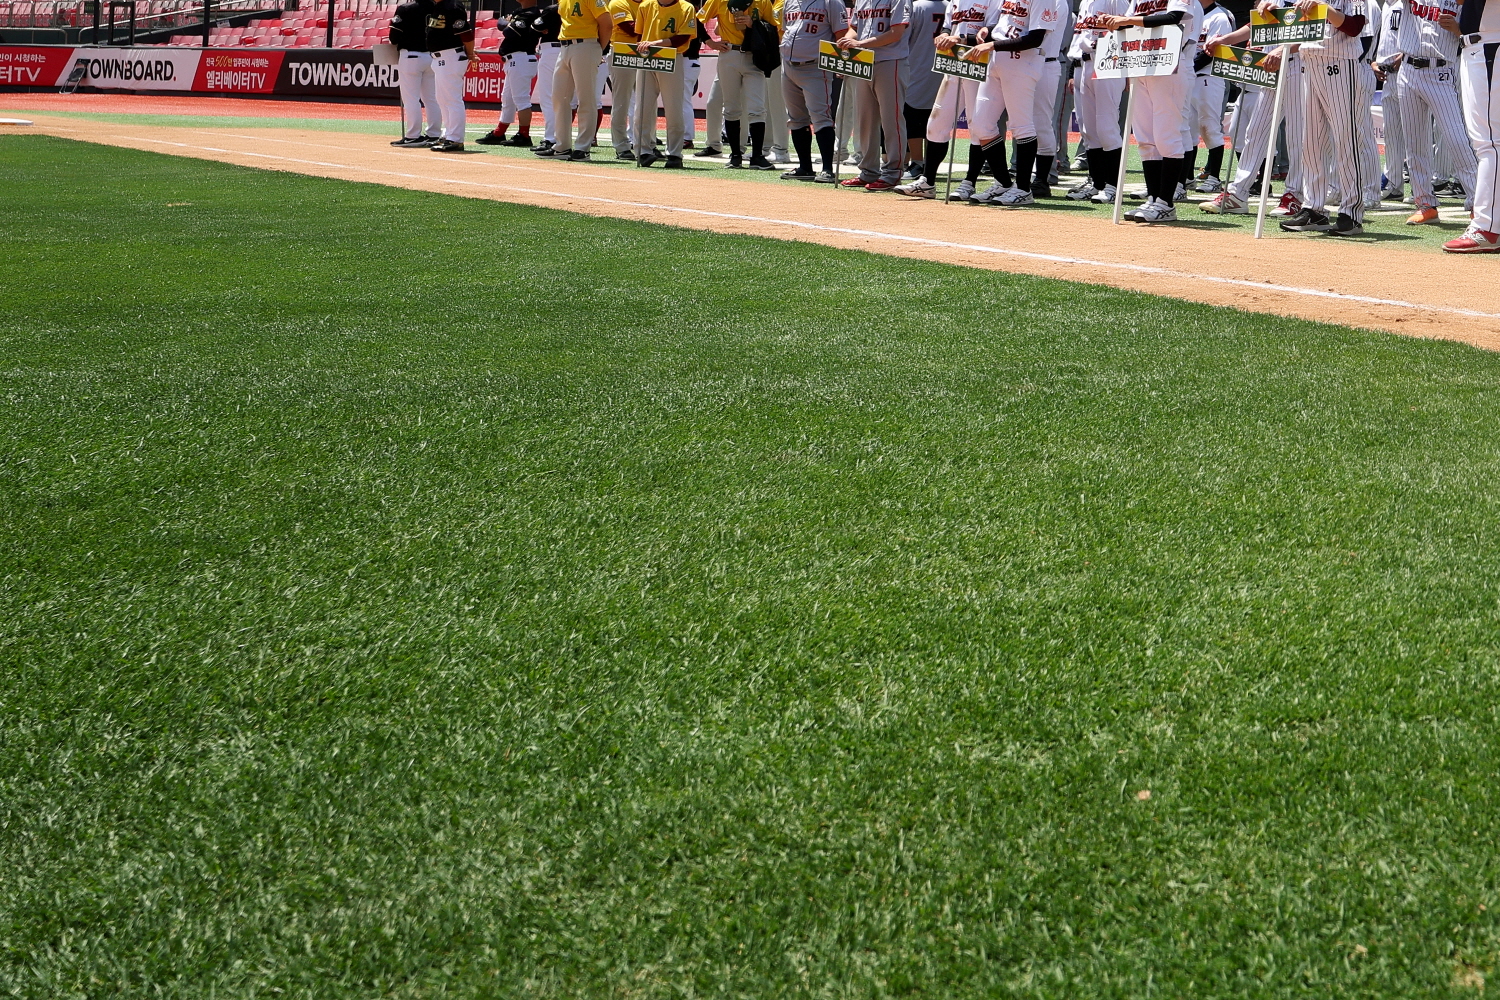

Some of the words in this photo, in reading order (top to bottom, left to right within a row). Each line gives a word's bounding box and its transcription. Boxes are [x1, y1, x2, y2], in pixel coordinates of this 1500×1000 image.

[571, 1, 583, 17] A
[661, 16, 676, 34] A
[805, 22, 818, 34] 16
[14, 53, 46, 63] 시청하는
[206, 58, 215, 67] 전국
[233, 58, 250, 68] 입주민이
[251, 58, 269, 68] 시청하는
[614, 55, 674, 71] 고양엔젤스야구단
[820, 55, 871, 77] 대구호크아이
[289, 62, 400, 88] TOWNBOARD
[968, 63, 986, 79] 야구부
[1213, 61, 1277, 85] 청주드래곤이어즈
[1327, 65, 1339, 76] 36
[1439, 72, 1449, 81] 27
[206, 71, 266, 90] 엘리베이터TV
